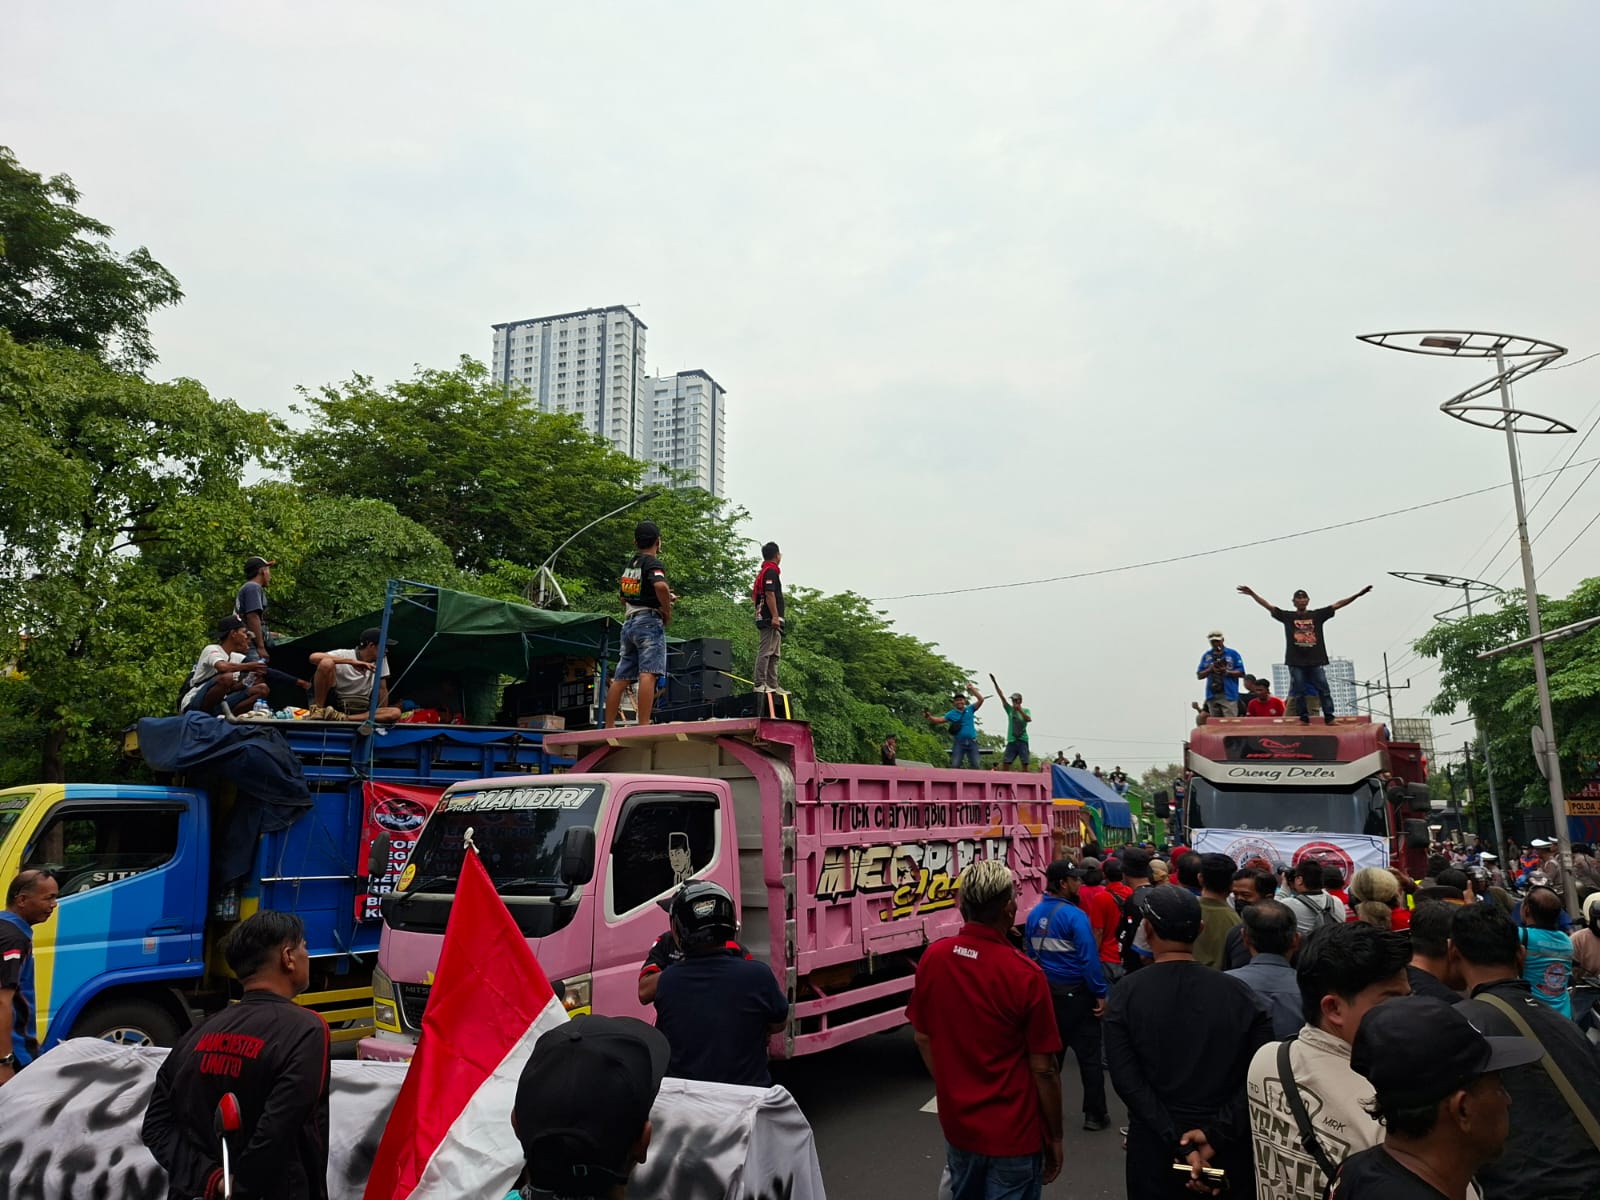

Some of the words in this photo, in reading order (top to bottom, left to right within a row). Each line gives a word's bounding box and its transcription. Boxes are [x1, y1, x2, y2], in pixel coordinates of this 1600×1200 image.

[1228, 767, 1281, 781] Oseng
[1287, 767, 1335, 778] Deles
[470, 787, 595, 811] MANDIRI
[1571, 802, 1596, 810] POLDA
[1321, 1116, 1347, 1134] MRK
